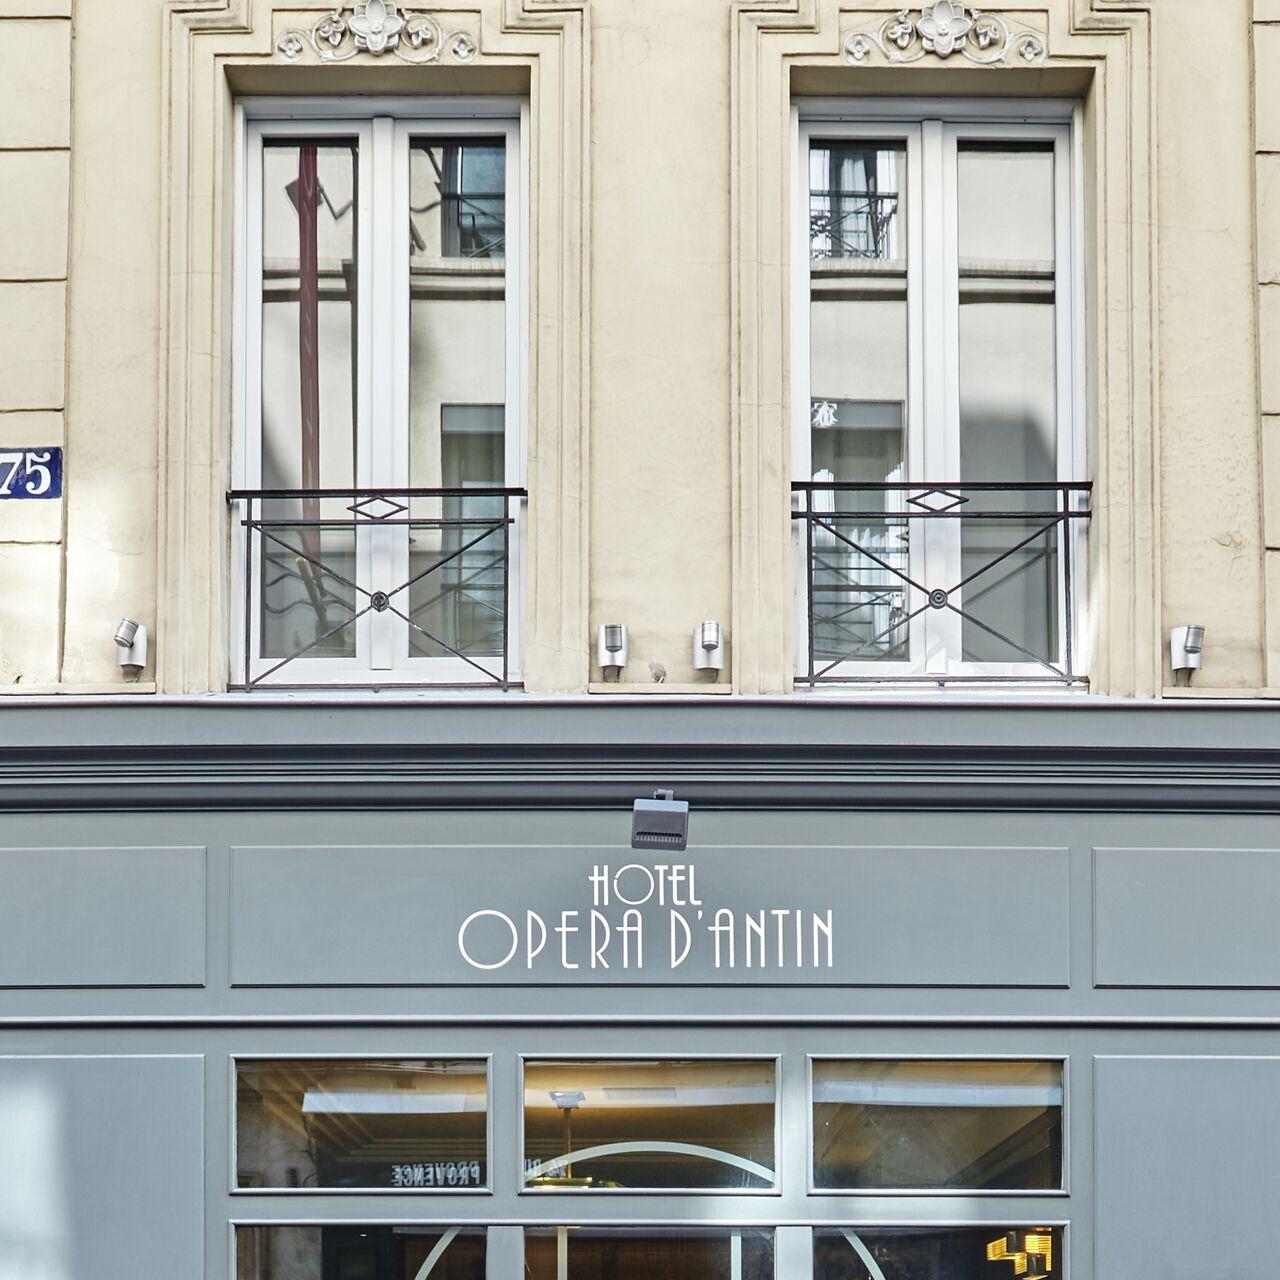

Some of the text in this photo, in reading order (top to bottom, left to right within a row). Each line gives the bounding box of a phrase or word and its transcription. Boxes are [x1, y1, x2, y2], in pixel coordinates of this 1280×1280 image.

[588, 863, 702, 906] HOTEL
[458, 908, 834, 970] OPERA D'ANTIN
